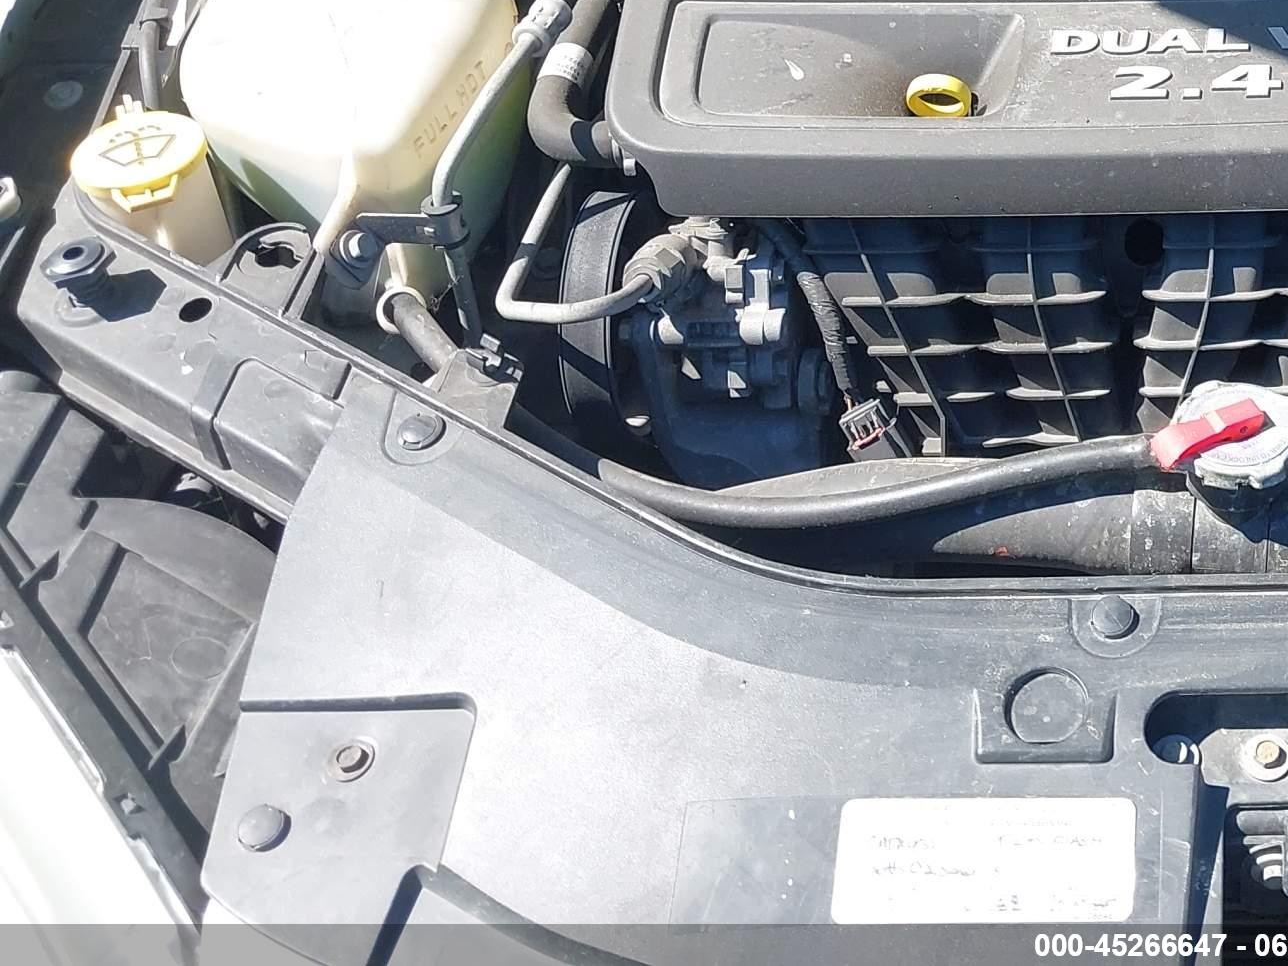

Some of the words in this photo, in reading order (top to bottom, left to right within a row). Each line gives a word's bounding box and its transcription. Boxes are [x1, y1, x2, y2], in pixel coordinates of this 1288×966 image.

[1050, 27, 1250, 55] DUAL
[1110, 64, 1283, 100] 2.4
[413, 103, 458, 159] FULL
